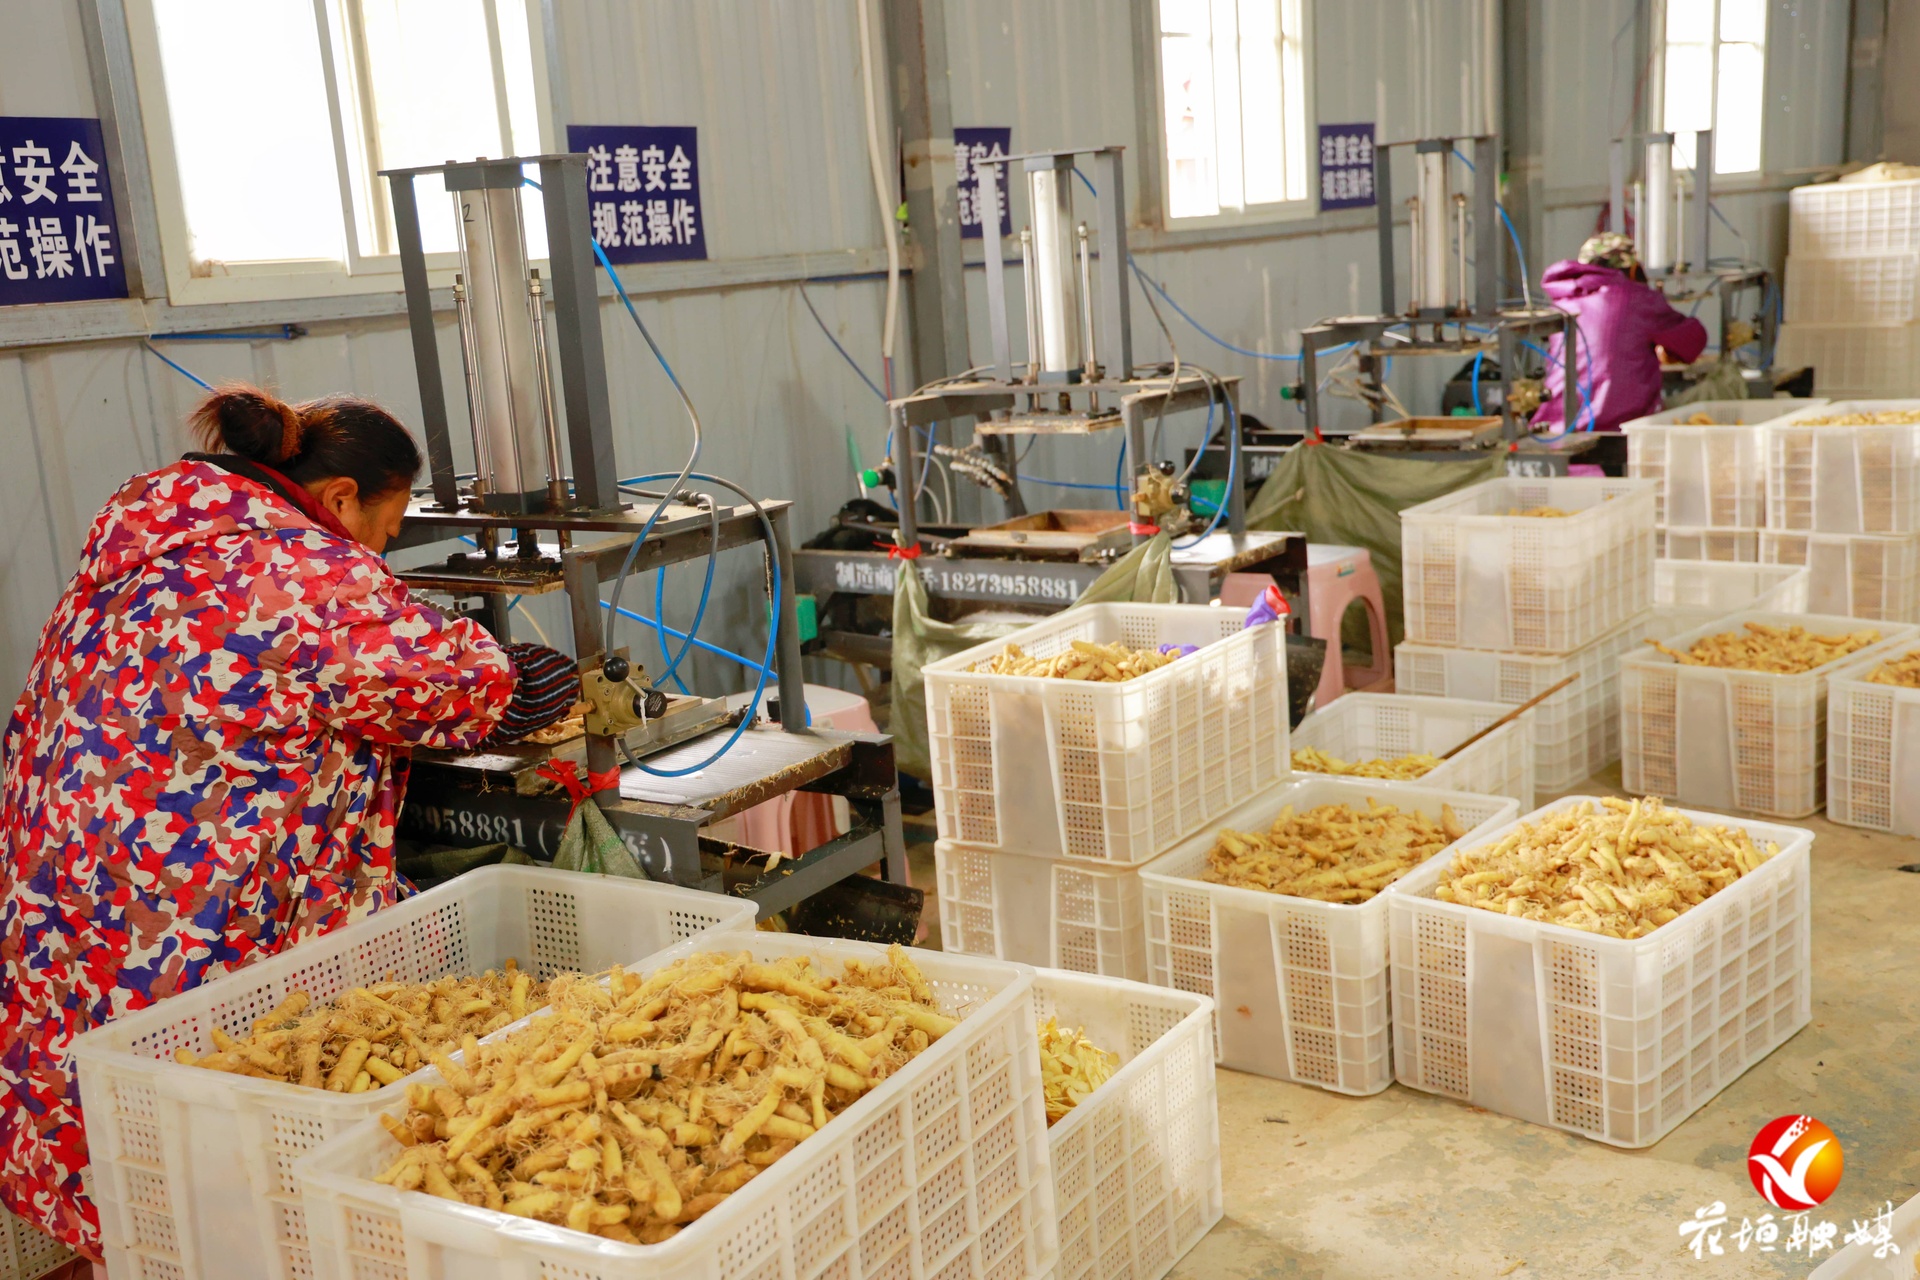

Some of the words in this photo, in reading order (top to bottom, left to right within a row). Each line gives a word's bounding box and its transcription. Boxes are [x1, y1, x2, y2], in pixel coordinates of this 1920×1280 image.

[587, 144, 693, 192] 注意安全
[462, 203, 475, 223] 2
[592, 198, 697, 248] 规范操作
